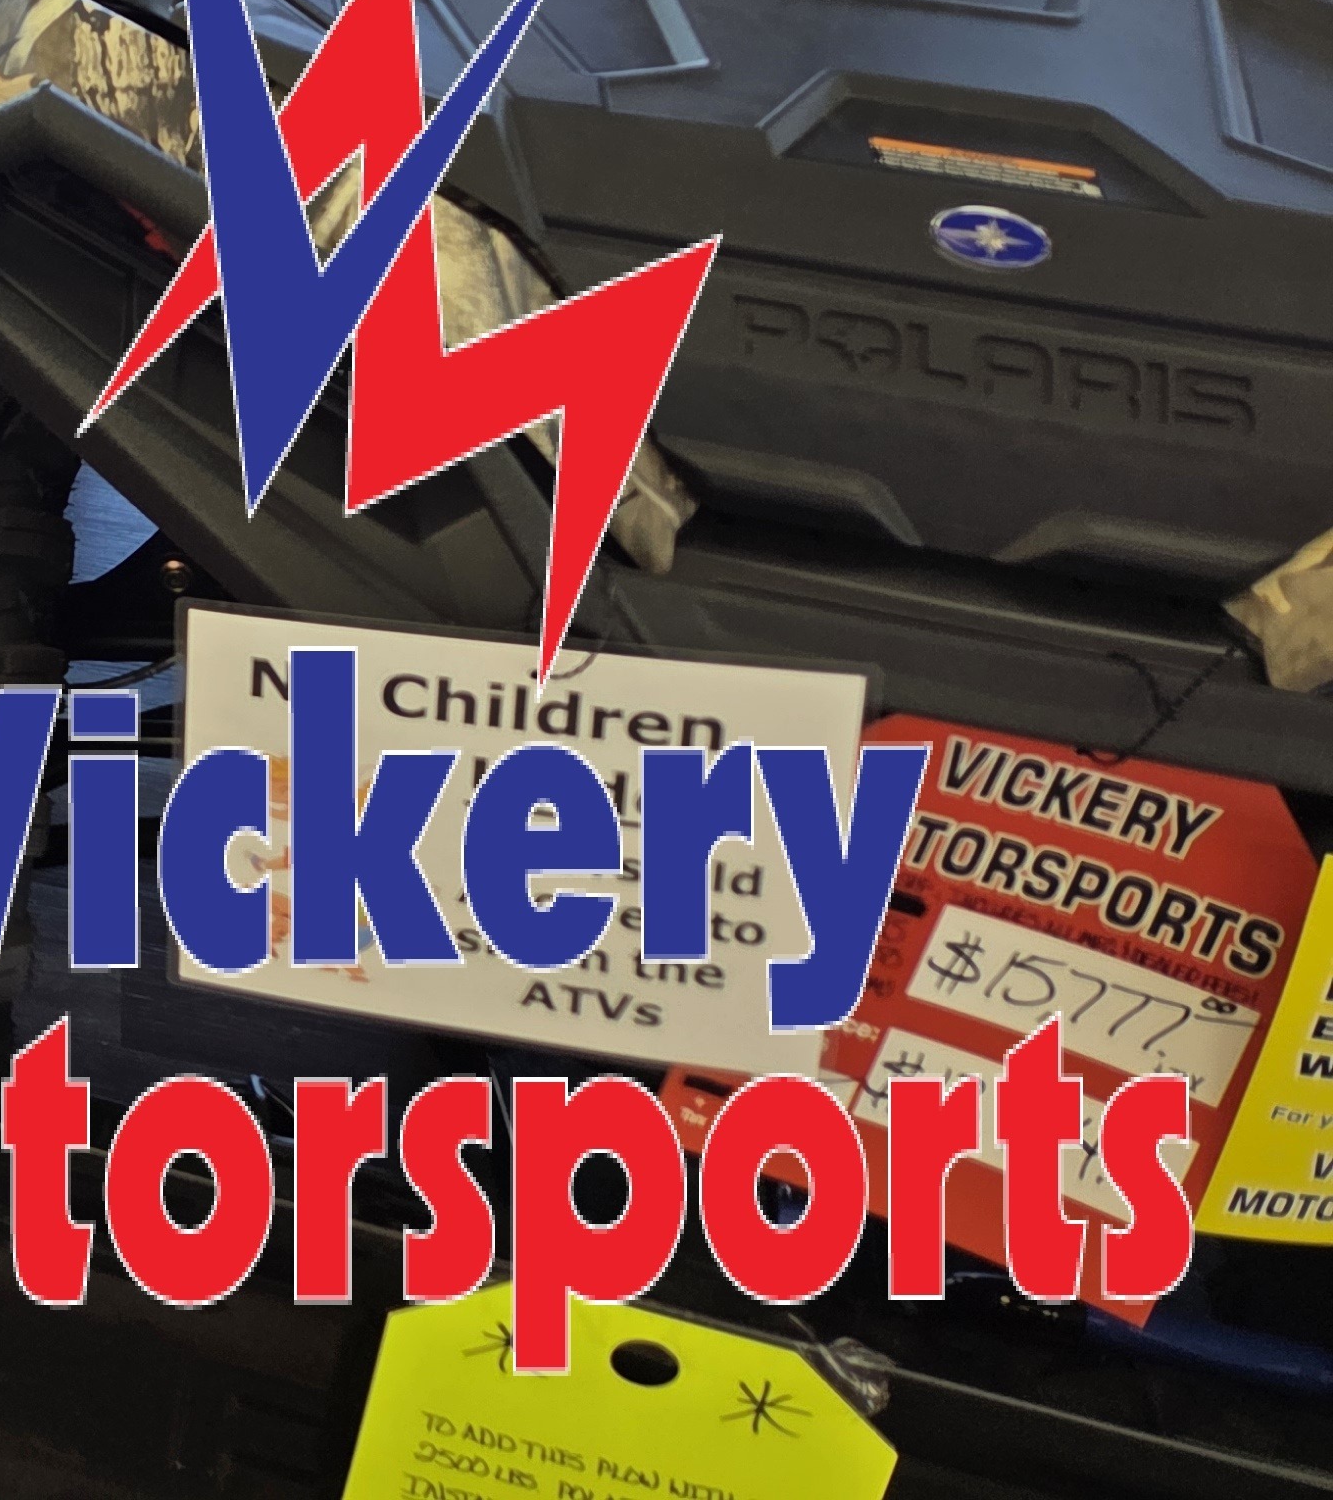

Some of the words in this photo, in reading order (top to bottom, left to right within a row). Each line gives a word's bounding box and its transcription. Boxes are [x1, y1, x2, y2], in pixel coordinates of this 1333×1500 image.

[733, 295, 1256, 434] POLARIS
[381, 673, 724, 752] Children
[938, 735, 1226, 860] VICKERY
[712, 911, 767, 946] to
[905, 815, 1287, 979] TORSPORTS
[520, 982, 663, 1029] ATVs
[633, 954, 727, 990] the
[1270, 1103, 1314, 1125] For
[420, 1409, 457, 1438] TO
[461, 1422, 519, 1454] ADD
[519, 1437, 587, 1474] THIS
[596, 1455, 661, 1490] PLOW
